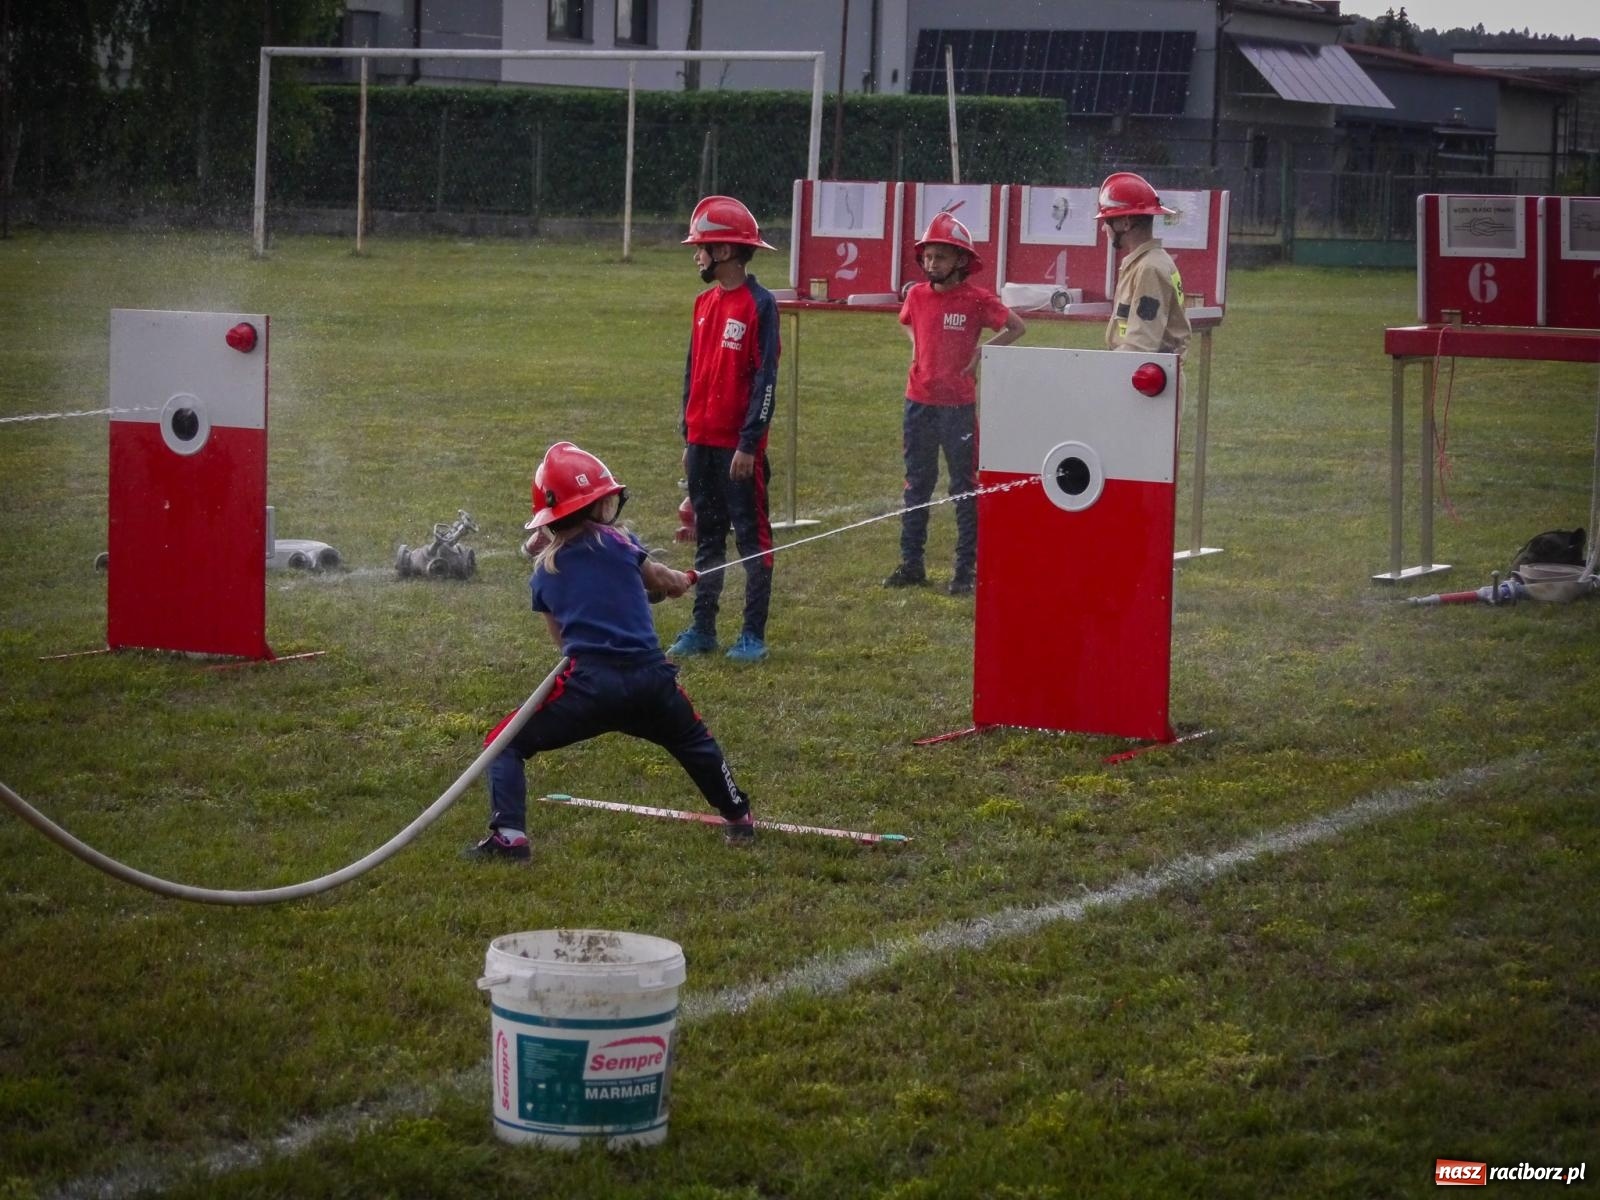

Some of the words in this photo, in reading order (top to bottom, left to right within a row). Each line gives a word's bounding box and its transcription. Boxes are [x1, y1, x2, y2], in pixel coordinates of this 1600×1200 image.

[835, 242, 858, 280] 2
[1044, 250, 1069, 287] 4
[1468, 262, 1498, 304] 6
[943, 313, 967, 326] MDP
[502, 1037, 510, 1111] Sempre
[590, 1051, 663, 1072] Sempre
[584, 1082, 657, 1100] MARMARE
